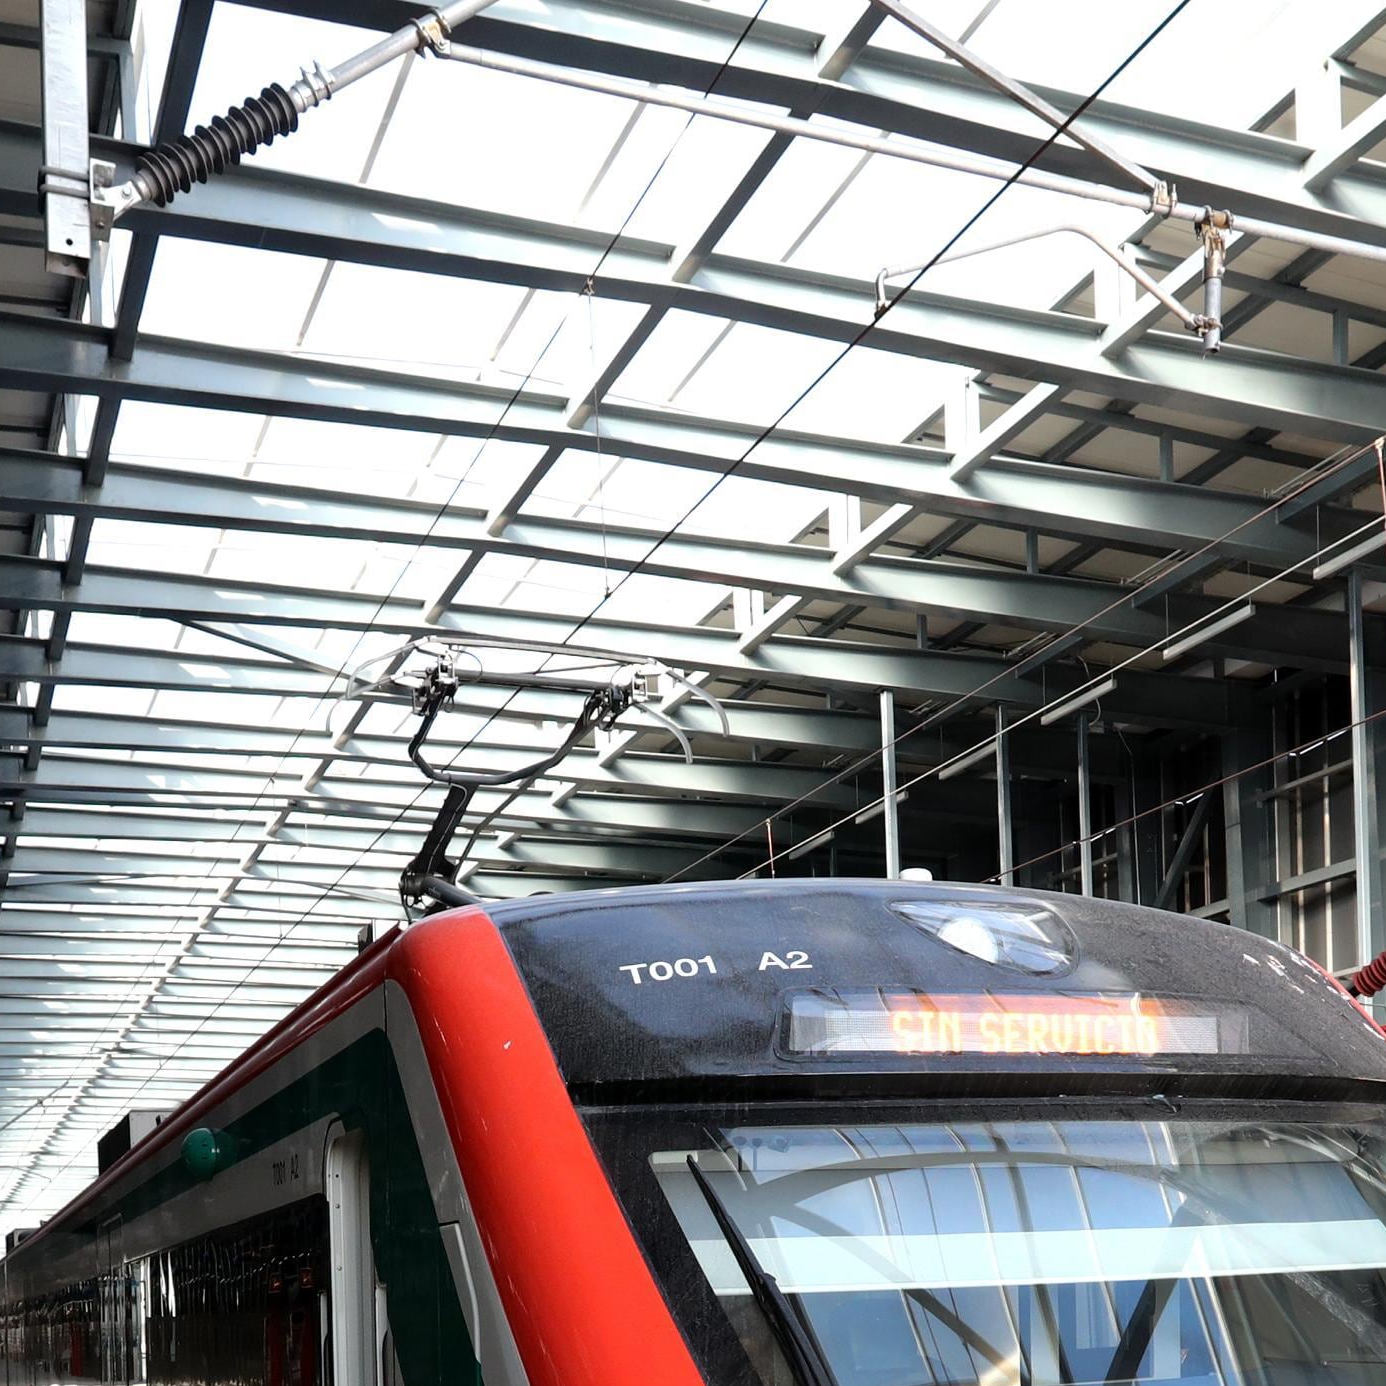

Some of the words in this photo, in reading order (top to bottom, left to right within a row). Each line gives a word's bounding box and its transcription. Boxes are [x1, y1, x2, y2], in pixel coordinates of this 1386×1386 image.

[619, 955, 717, 984] T001
[758, 951, 813, 970] A2
[891, 1010, 961, 1053] SIN
[979, 1011, 1159, 1055] SERVICIO
